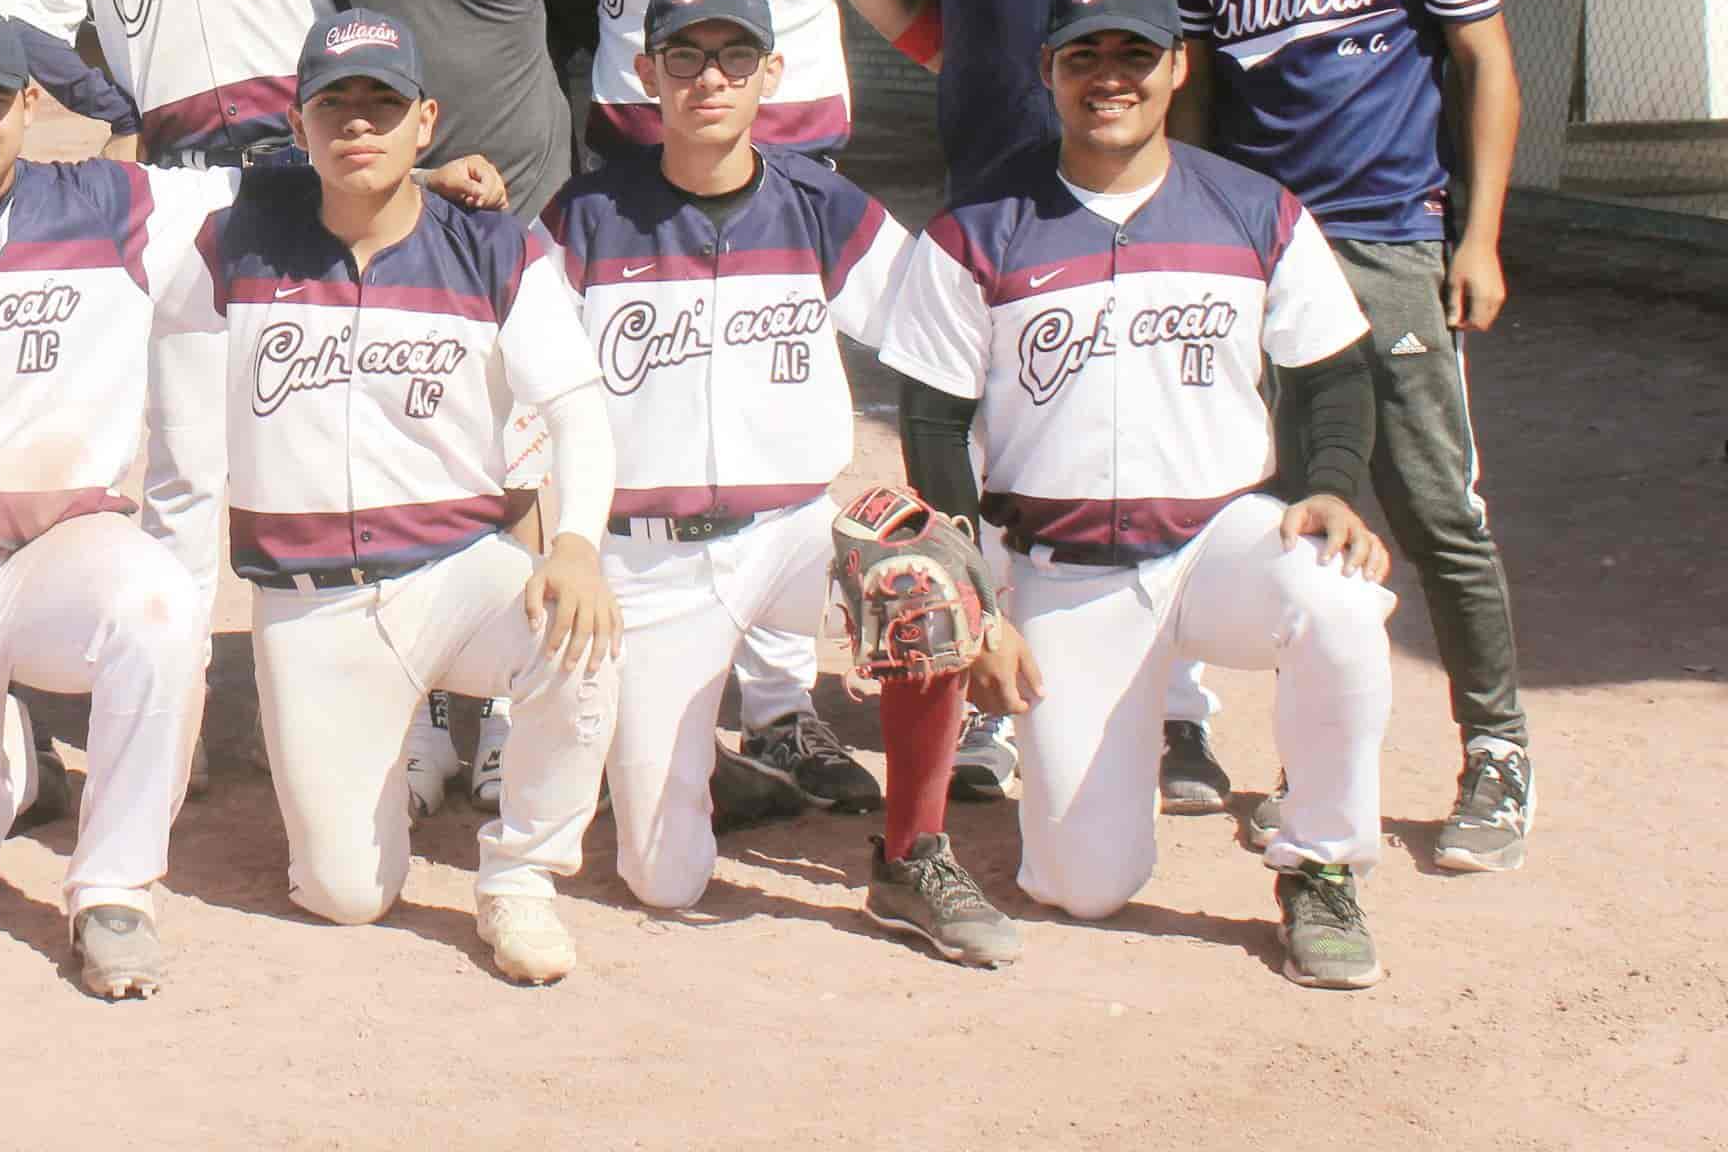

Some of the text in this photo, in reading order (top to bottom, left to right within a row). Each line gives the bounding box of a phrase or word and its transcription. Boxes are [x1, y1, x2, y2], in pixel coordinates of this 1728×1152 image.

[17, 330, 60, 373] AC
[771, 343, 810, 383] AC
[1180, 343, 1213, 386] AC
[405, 377, 444, 419] AC
